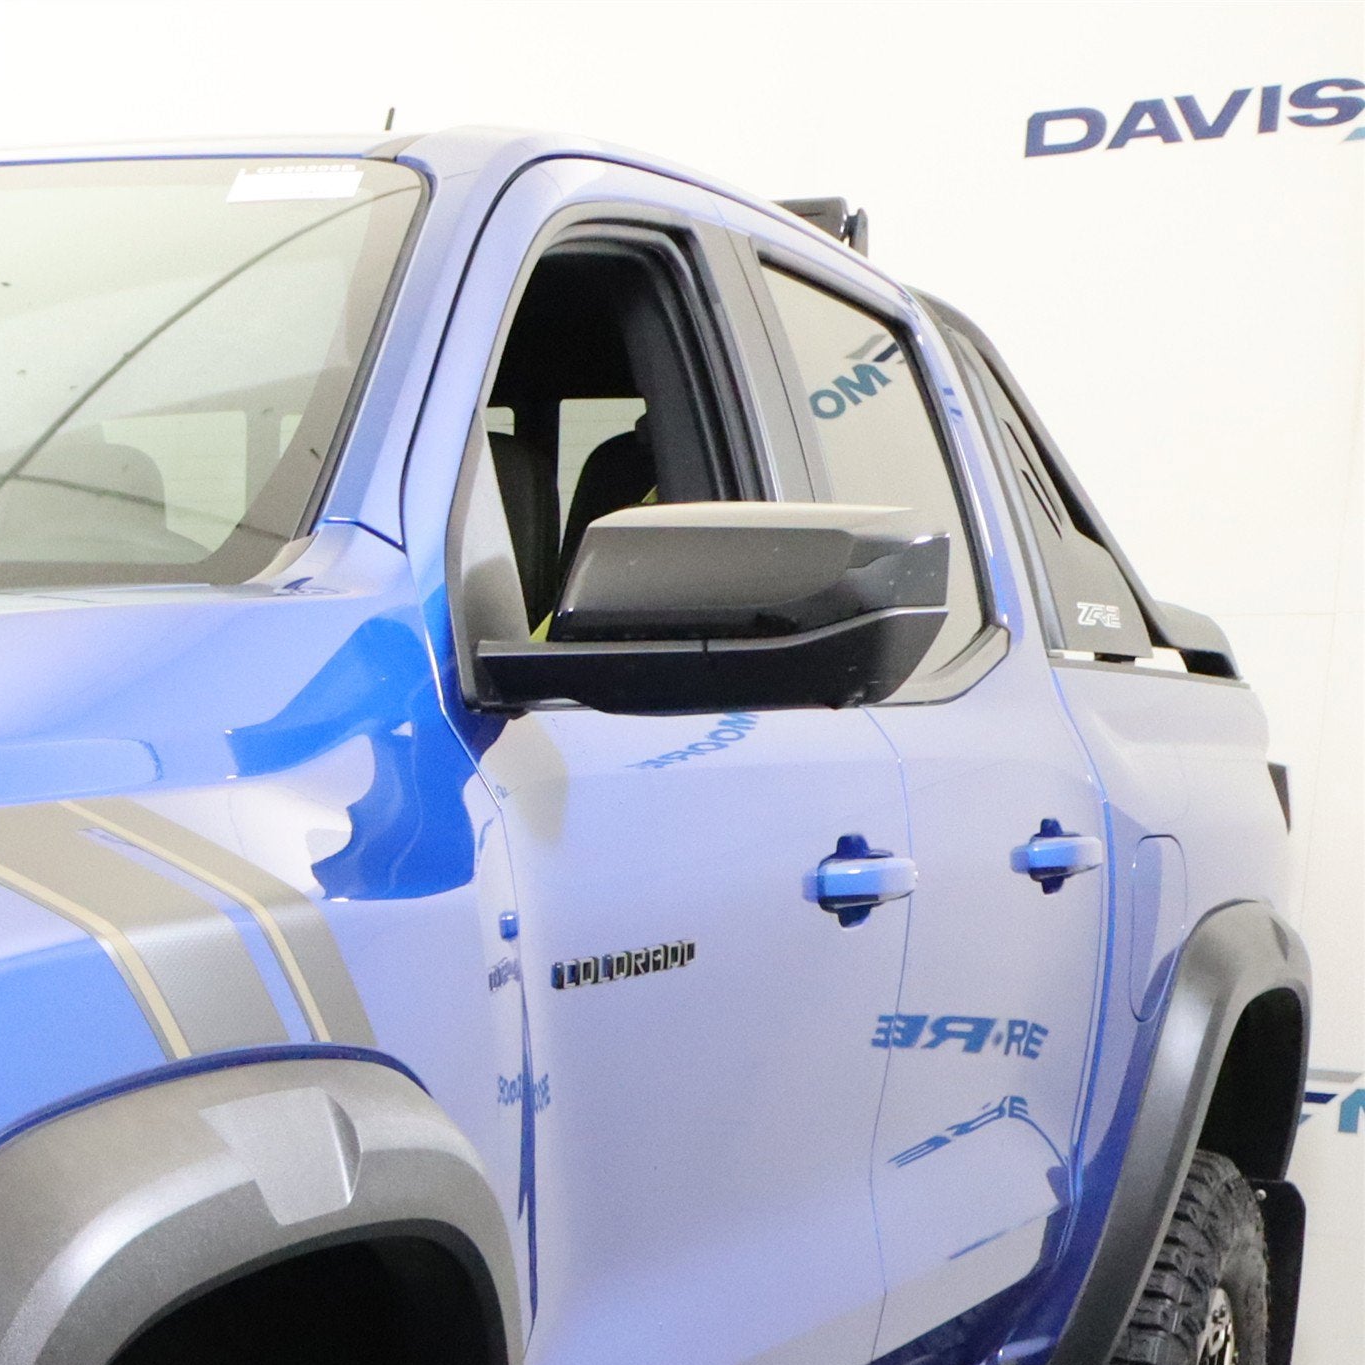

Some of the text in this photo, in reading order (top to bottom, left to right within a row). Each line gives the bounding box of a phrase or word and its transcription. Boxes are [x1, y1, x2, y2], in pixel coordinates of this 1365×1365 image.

[1023, 77, 1365, 158] DAVIS
[1076, 601, 1122, 629] ZR2
[551, 938, 697, 990] COLORADO
